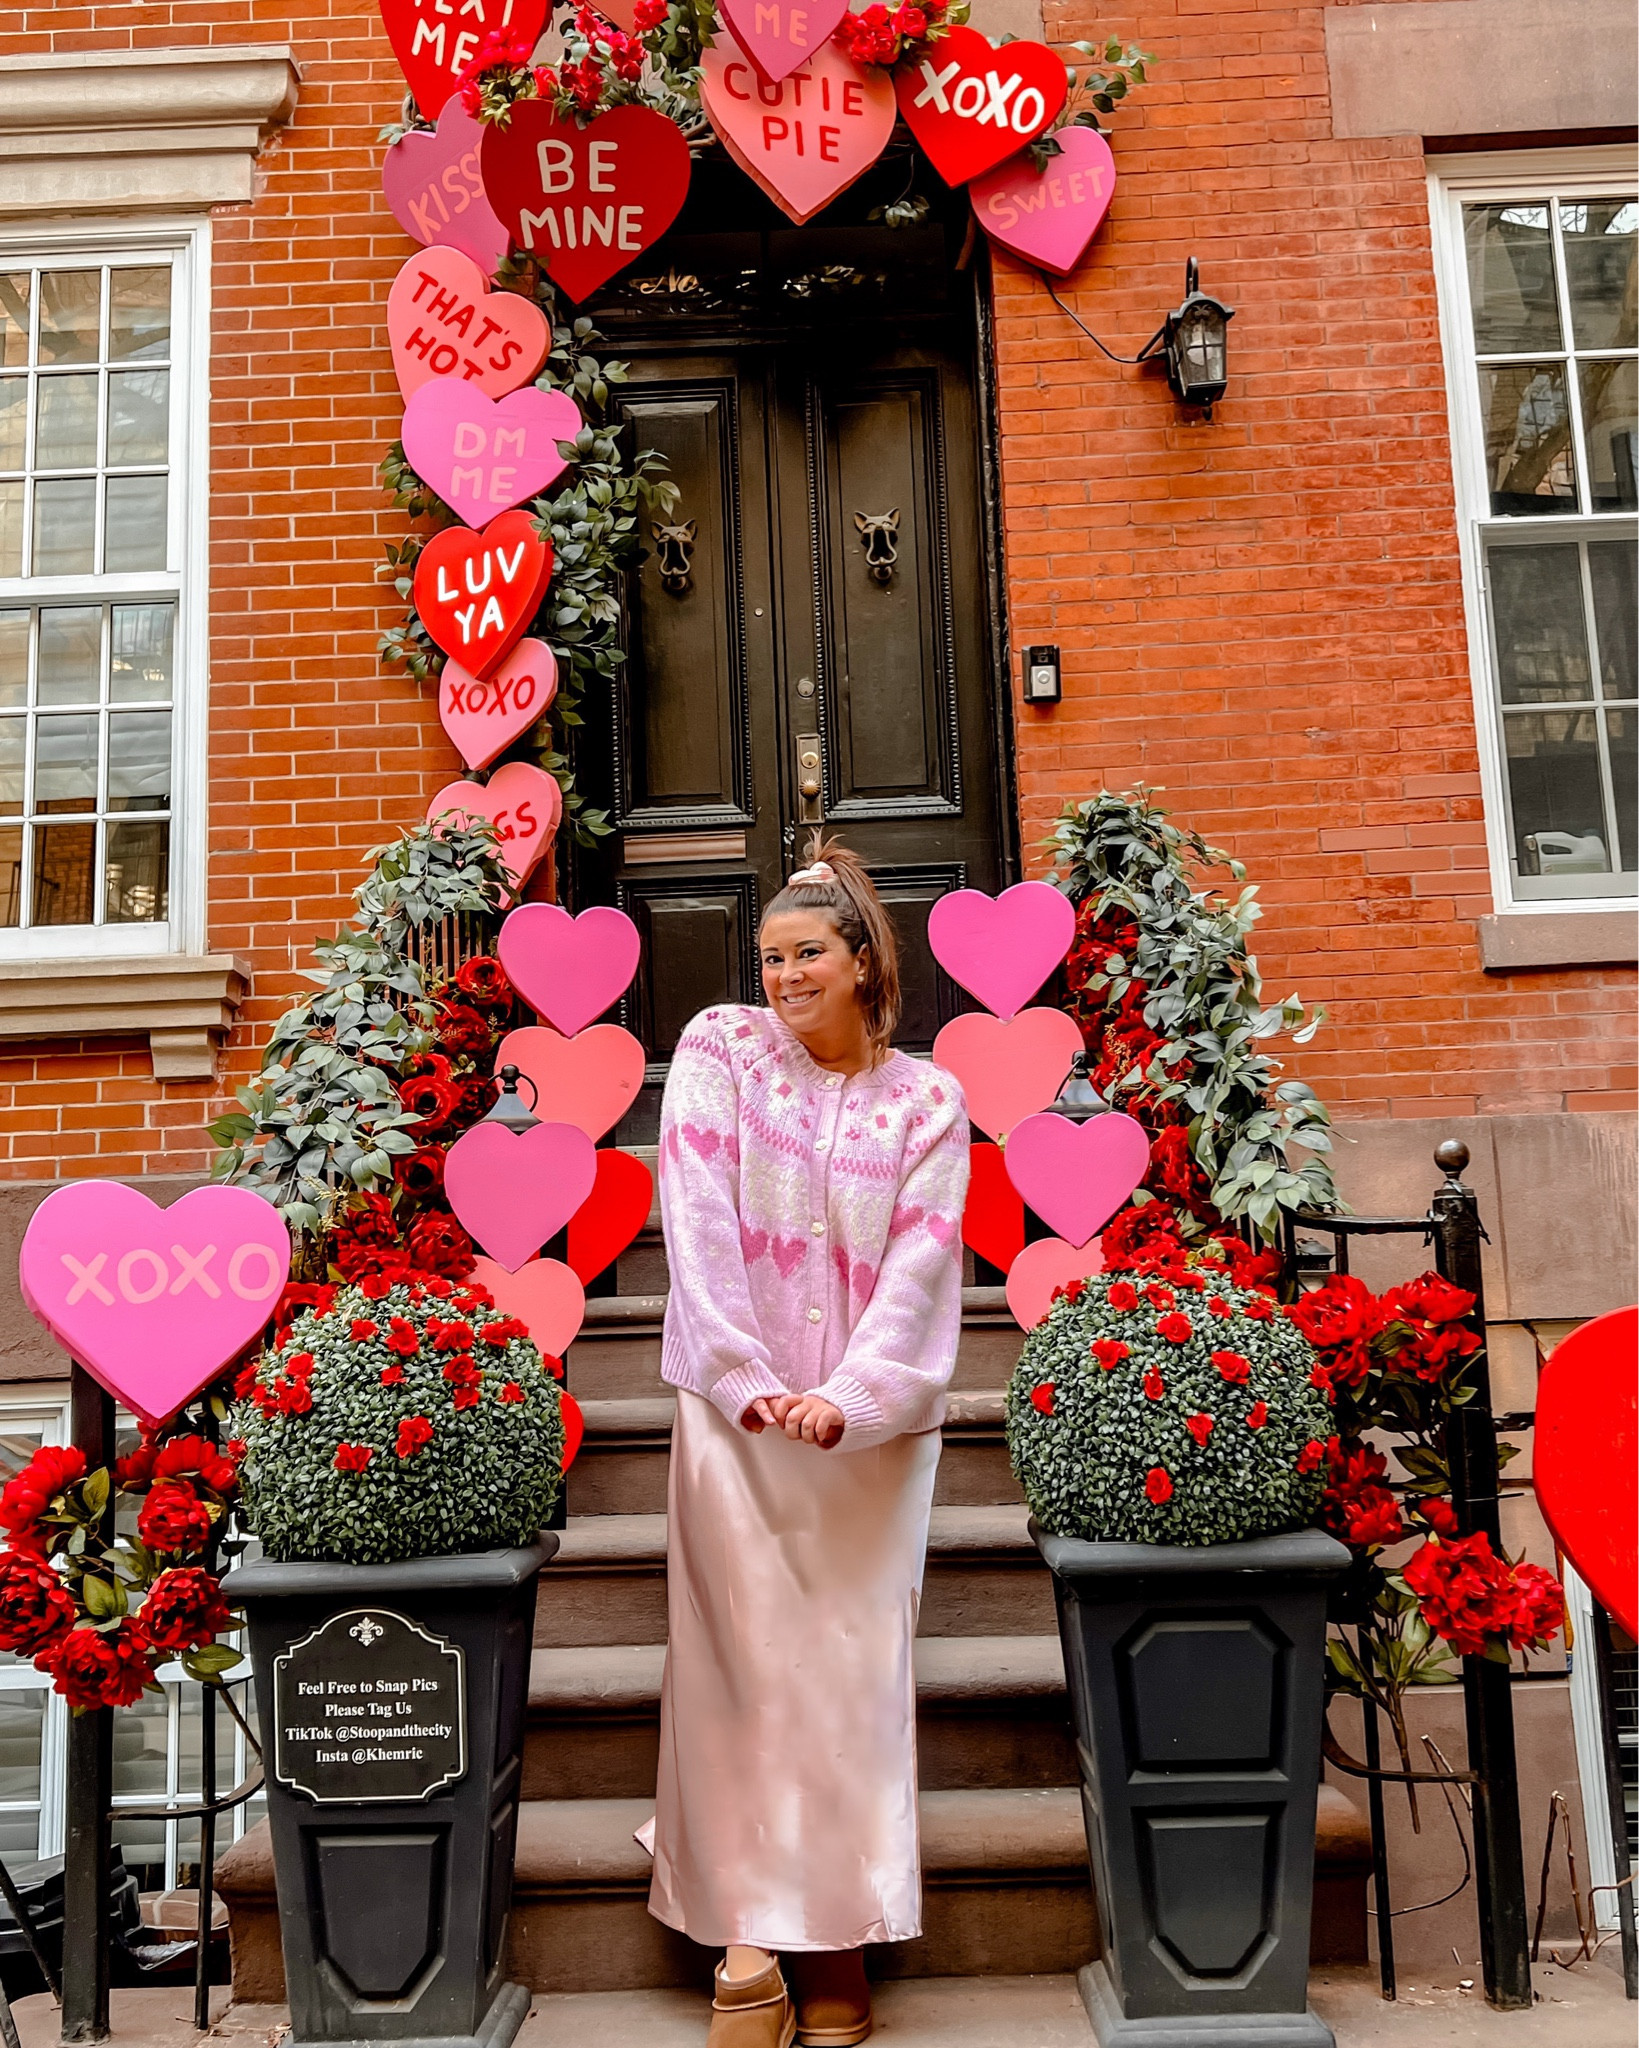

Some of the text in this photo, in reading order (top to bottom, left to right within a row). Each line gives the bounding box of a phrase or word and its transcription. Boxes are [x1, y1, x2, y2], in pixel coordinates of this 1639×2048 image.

[411, 18, 479, 75] ME
[755, 3, 808, 47] ME
[724, 62, 864, 116] CUTIE
[913, 59, 1045, 134] XOXO
[762, 115, 840, 163] PIE
[537, 139, 619, 194] BE
[988, 166, 1106, 230] SWEET
[520, 205, 644, 251] MINE
[411, 271, 523, 371] THAT'S
[453, 421, 526, 458] DM
[450, 465, 517, 504] ME
[437, 541, 525, 602] LUV
[454, 595, 505, 645] YA
[447, 675, 536, 717] XOXO
[60, 1243, 280, 1306] XOXO
[298, 1678, 438, 1695] Feel Free to Snap Pics
[325, 1701, 412, 1718] Please Tag Us
[285, 1723, 452, 1742] TikTok @Stoopandthecity
[316, 1747, 423, 1764] Insta @Khemric
